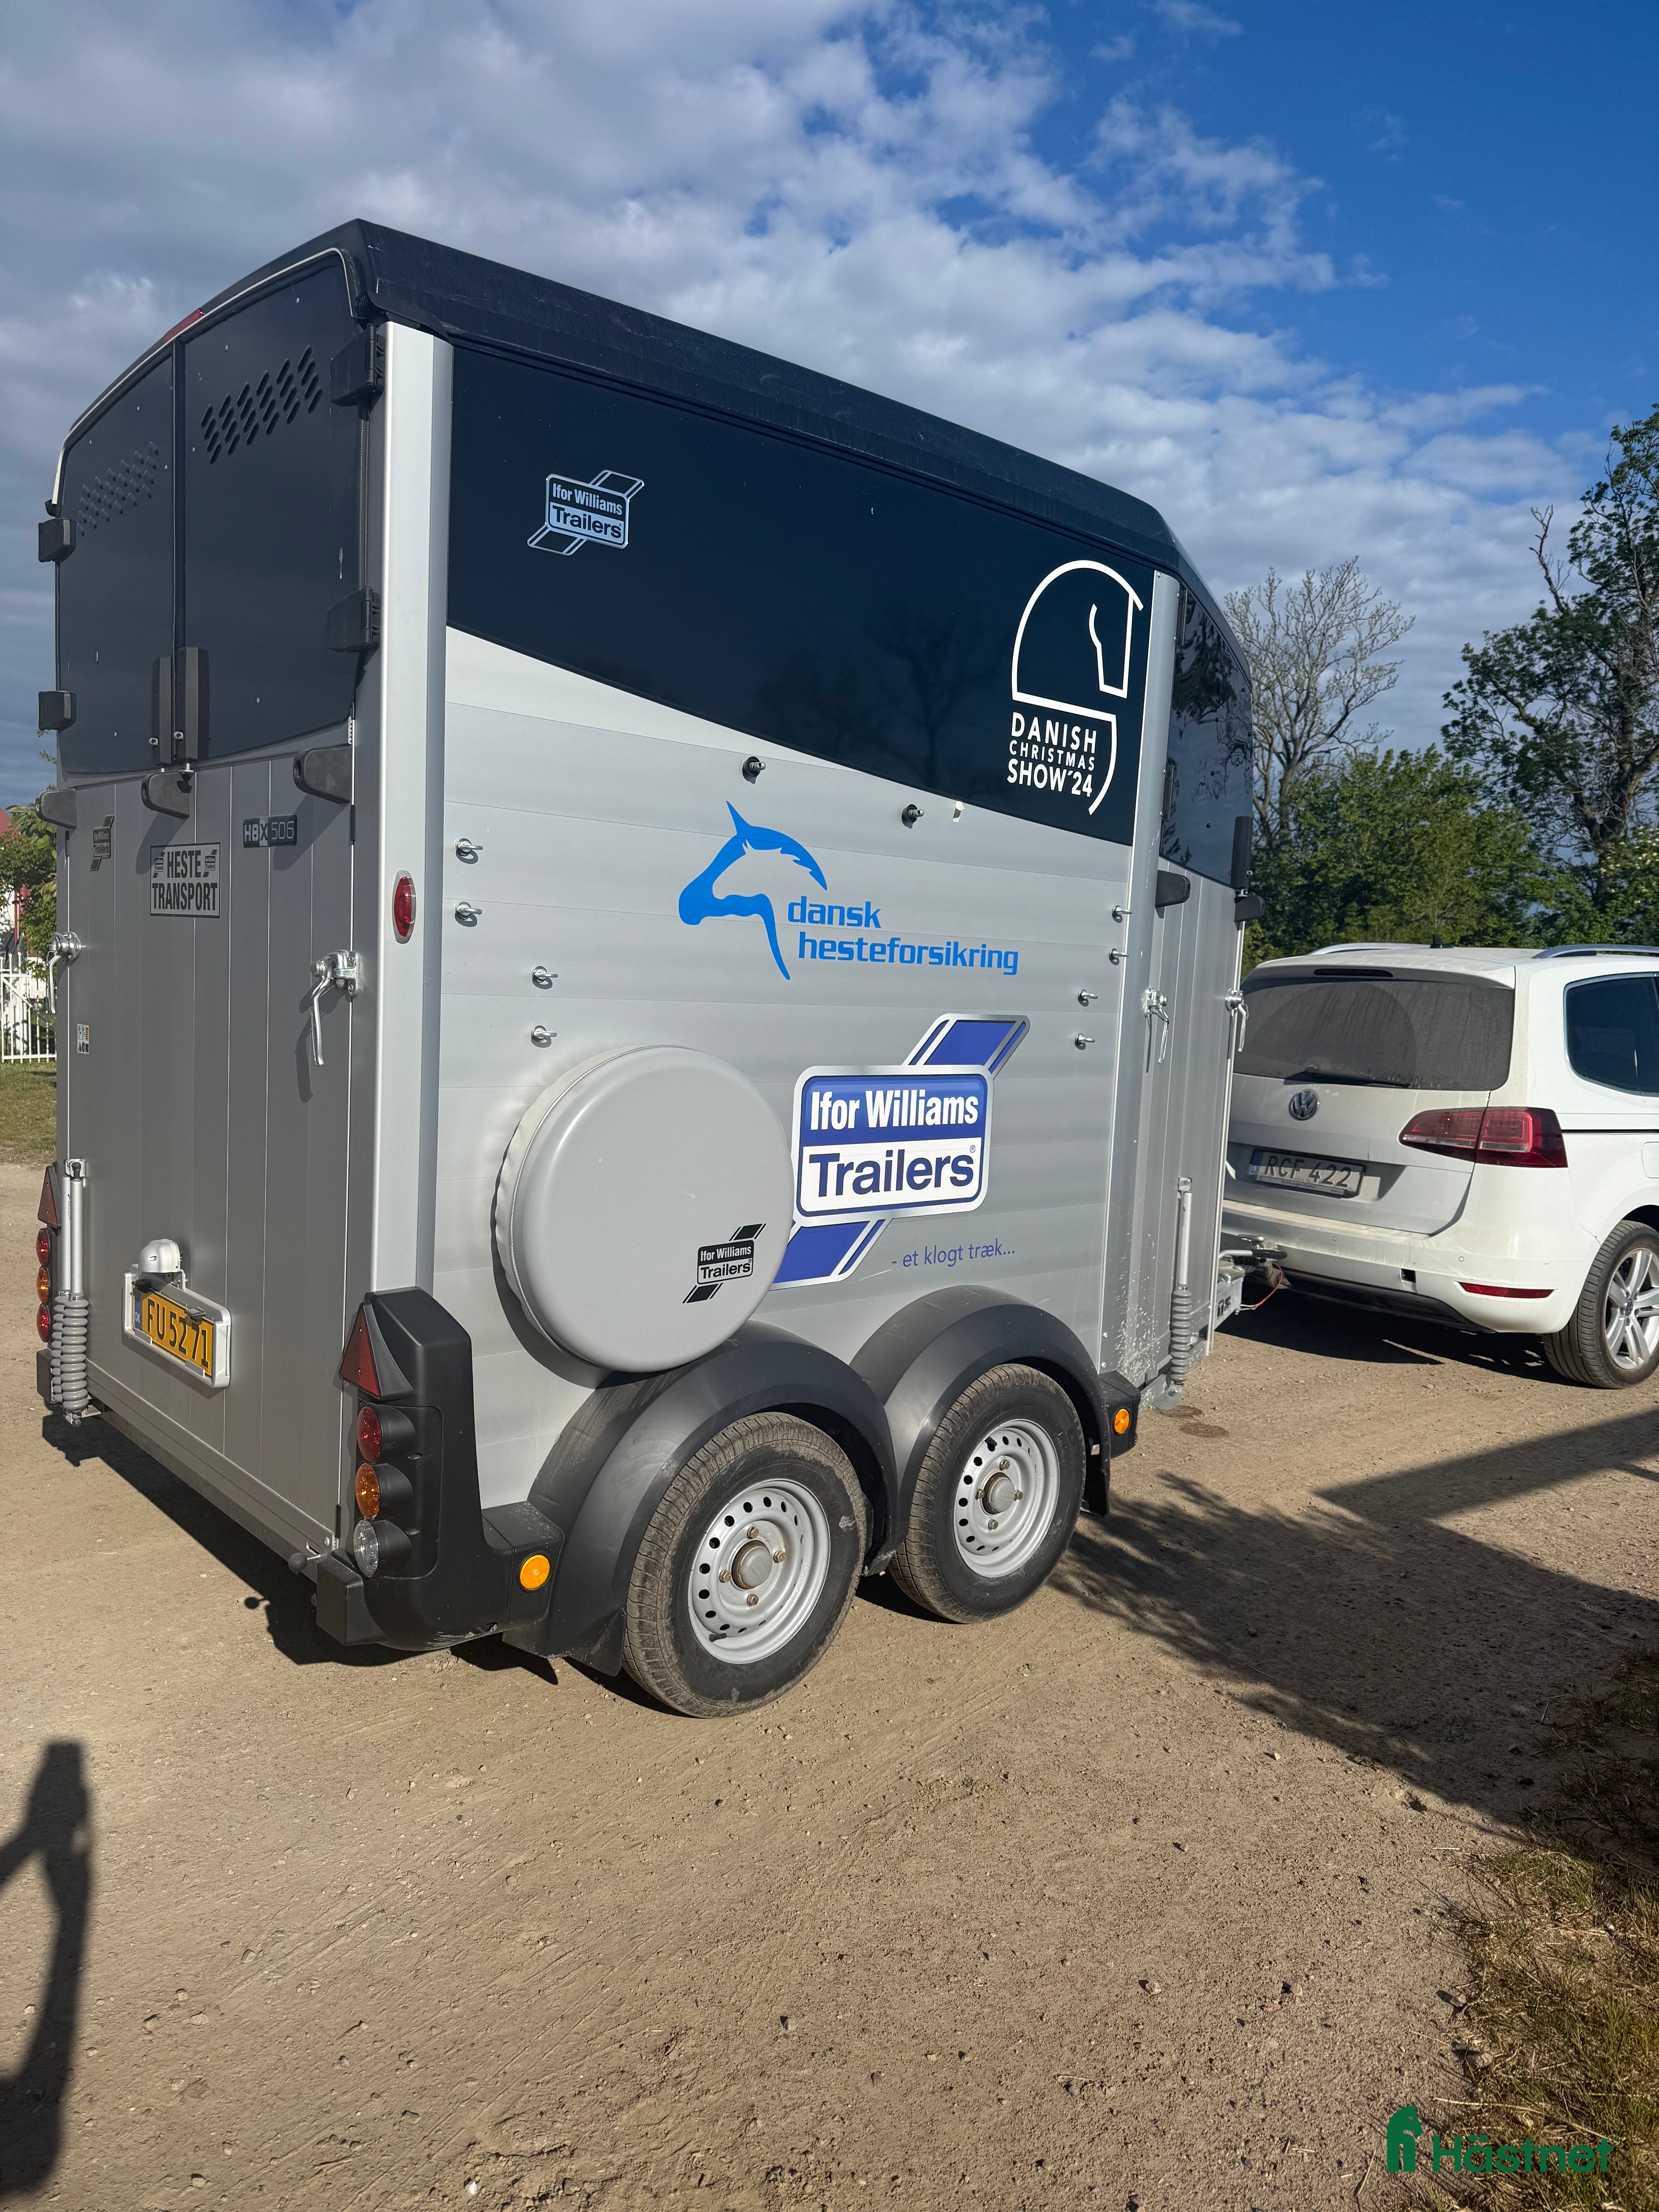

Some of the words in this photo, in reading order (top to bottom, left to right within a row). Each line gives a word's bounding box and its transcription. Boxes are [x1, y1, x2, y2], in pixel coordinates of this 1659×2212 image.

[553, 483, 572, 501] Ifor
[574, 489, 622, 515] Williams
[1011, 712, 1096, 754] DANISH
[1009, 740, 1095, 771] CHRISTMAS
[244, 823, 268, 842] HBX
[271, 821, 294, 840] 506
[167, 850, 201, 878] HESTE
[152, 882, 218, 910] TRANSPORT
[788, 896, 881, 928] dansk
[799, 931, 1018, 975] hesteforsikring
[811, 1091, 860, 1130] Ifor
[865, 1089, 979, 1128] Williams
[1265, 1155, 1304, 1178] RCF
[1309, 1162, 1351, 1187] 422
[700, 1250, 715, 1262] Ifor
[716, 1246, 751, 1259] Williams
[903, 1251, 919, 1267] et
[924, 1245, 963, 1267] klogt
[135, 1311, 141, 1324] DK
